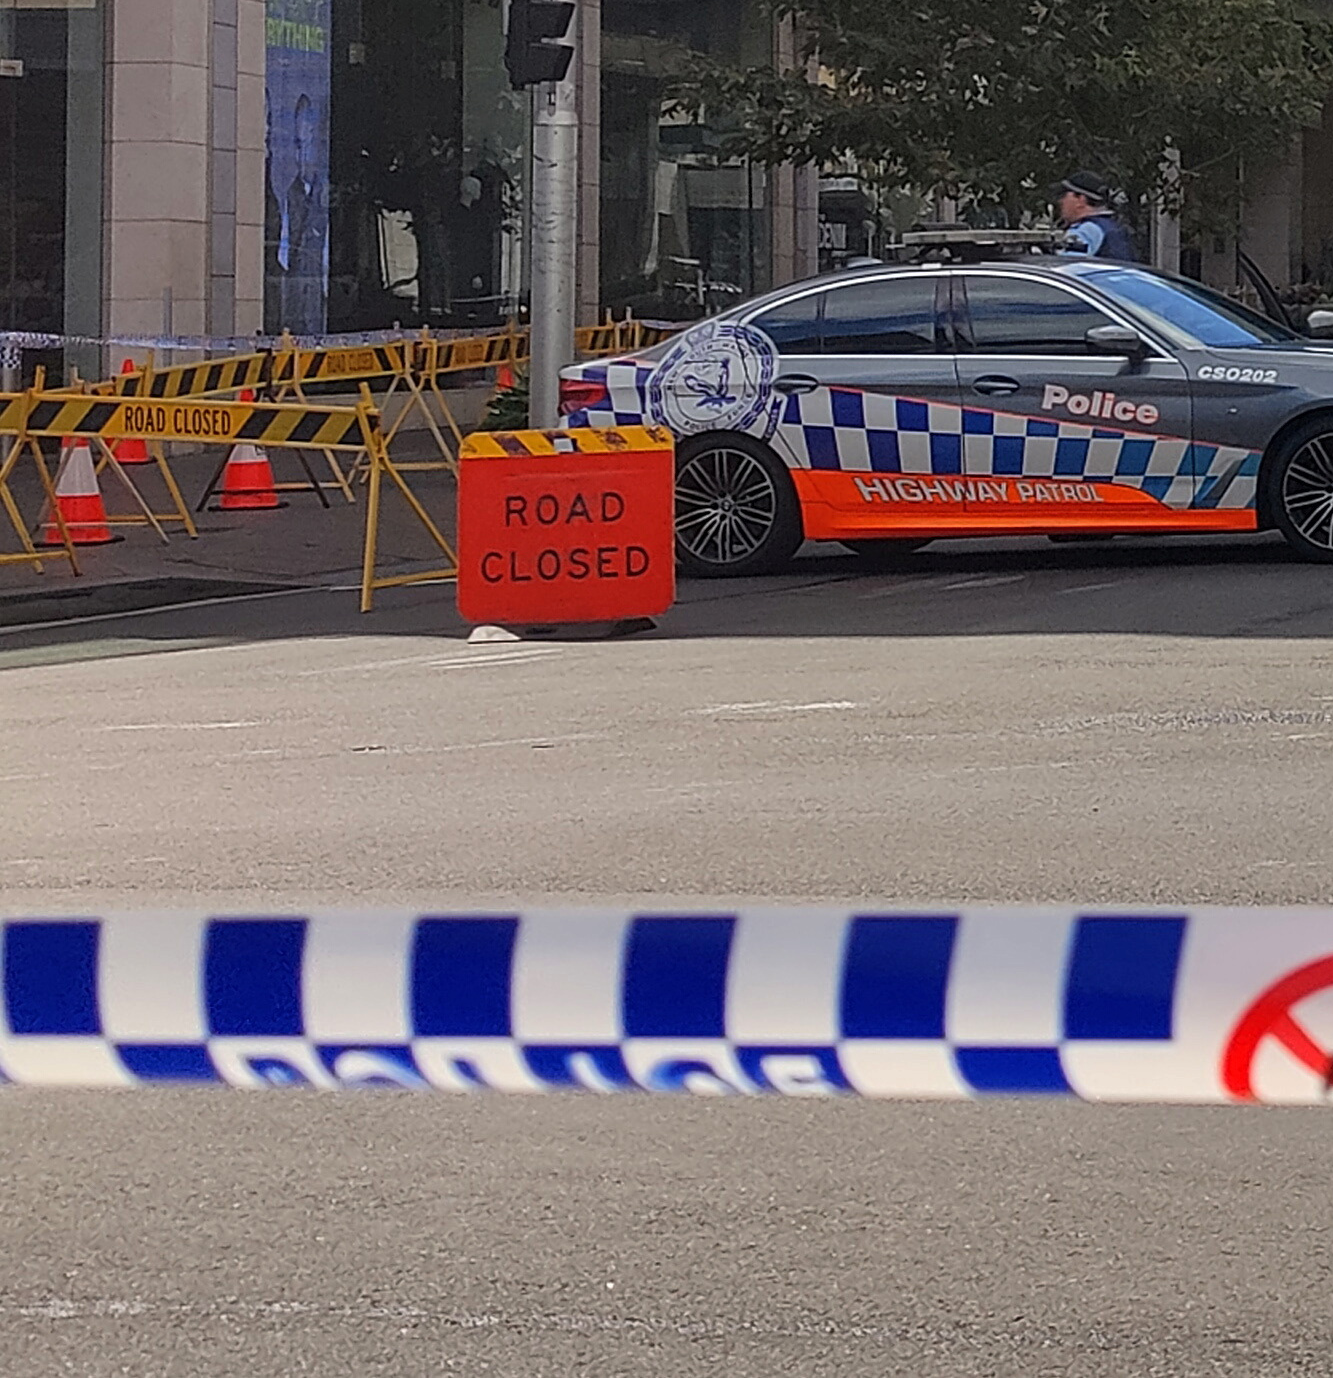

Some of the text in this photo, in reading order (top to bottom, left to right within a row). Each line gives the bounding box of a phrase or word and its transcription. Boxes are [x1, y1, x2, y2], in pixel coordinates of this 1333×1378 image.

[125, 406, 231, 435] ROAD CLOSED
[1041, 383, 1160, 425] Police
[853, 477, 1104, 504] HIGHWAY PATROL
[504, 491, 625, 527] ROAD
[480, 545, 650, 584] CLOSED
